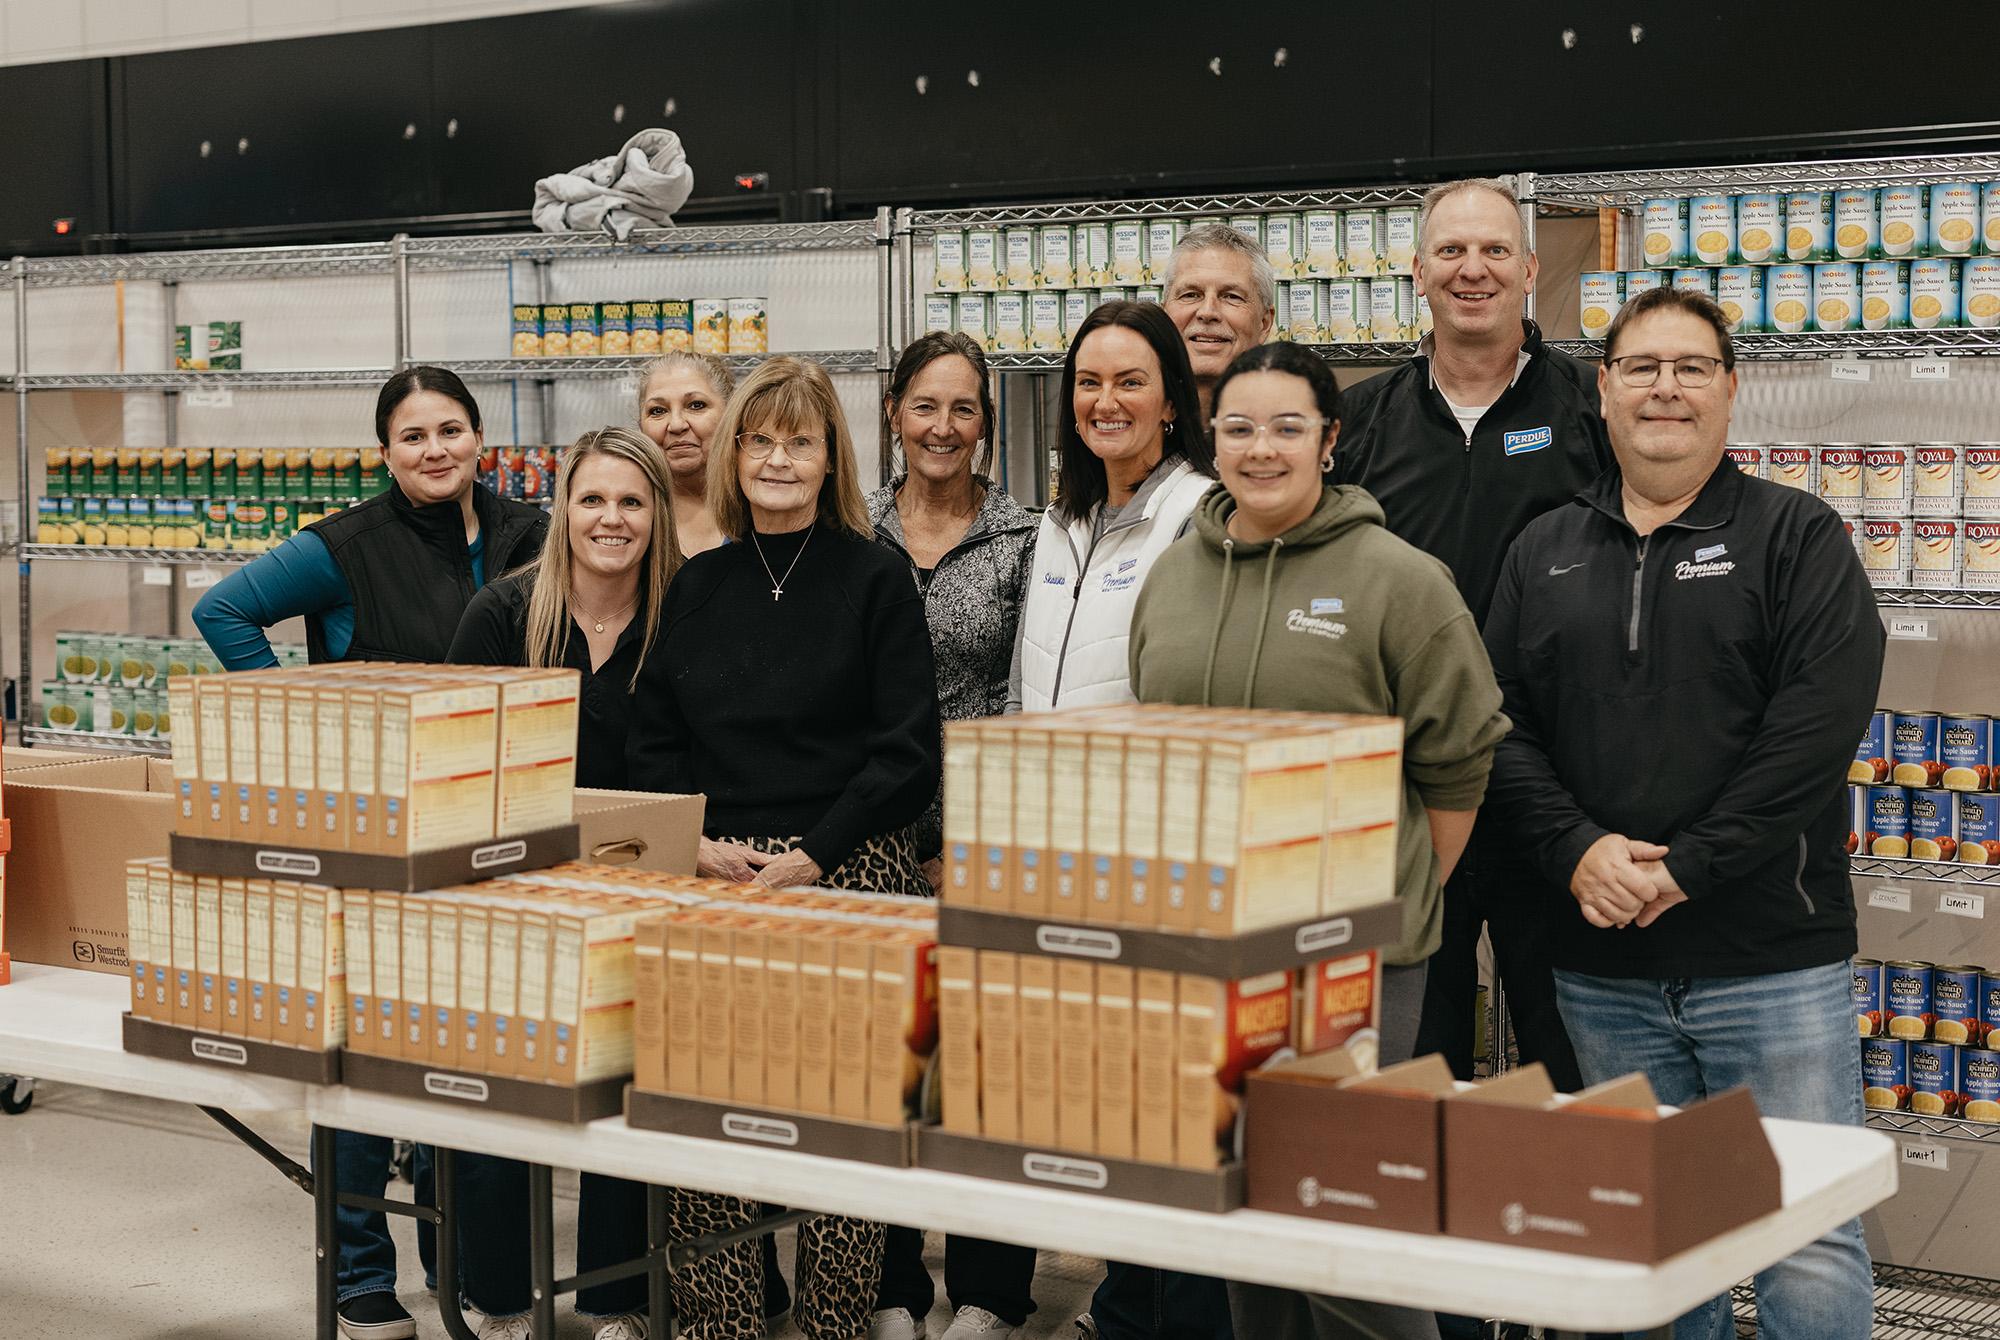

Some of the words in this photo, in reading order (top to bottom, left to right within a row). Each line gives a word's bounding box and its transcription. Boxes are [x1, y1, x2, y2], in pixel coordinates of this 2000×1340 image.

[1916, 366, 1936, 374] Limit
[1508, 430, 1547, 445] PERDUE
[1727, 452, 1755, 461] OYAL
[1773, 452, 1805, 463] ROYAL
[1826, 452, 1860, 464] ROYAL
[1867, 454, 1899, 466] ROYAL
[1917, 452, 1949, 464] ROYAL
[1967, 452, 2000, 464] ROYAL
[1865, 525, 1895, 536] ROYAL
[1916, 525, 1950, 538] ROYAL
[1968, 526, 2000, 539] ROYAL
[1675, 561, 1735, 578] Premium
[1102, 573, 1136, 589] Premium
[1286, 609, 1349, 635] Premium
[1895, 624, 1915, 632] Limit
[1946, 733, 1974, 741] RICHFIELD
[1908, 743, 1926, 751] Sauce
[1943, 747, 1959, 756] Apple
[1960, 747, 1979, 755] Sauce
[1876, 802, 1905, 810] RICHFIELD
[1872, 815, 1889, 824] Apple
[1890, 816, 1908, 824] Sauce
[1921, 819, 1940, 827] Sauce
[1968, 822, 1987, 831] Sauce
[96, 944, 126, 957] Smurfit
[1892, 982, 1921, 990] RICHFIELD
[1889, 995, 1905, 1004] Apple
[1906, 996, 1925, 1004] Sauce
[1947, 1000, 1967, 1008] Sauce
[1968, 1065, 1998, 1073] RICHFIELD
[1924, 1072, 1944, 1080] Sauce
[1966, 1078, 1983, 1087] Apple
